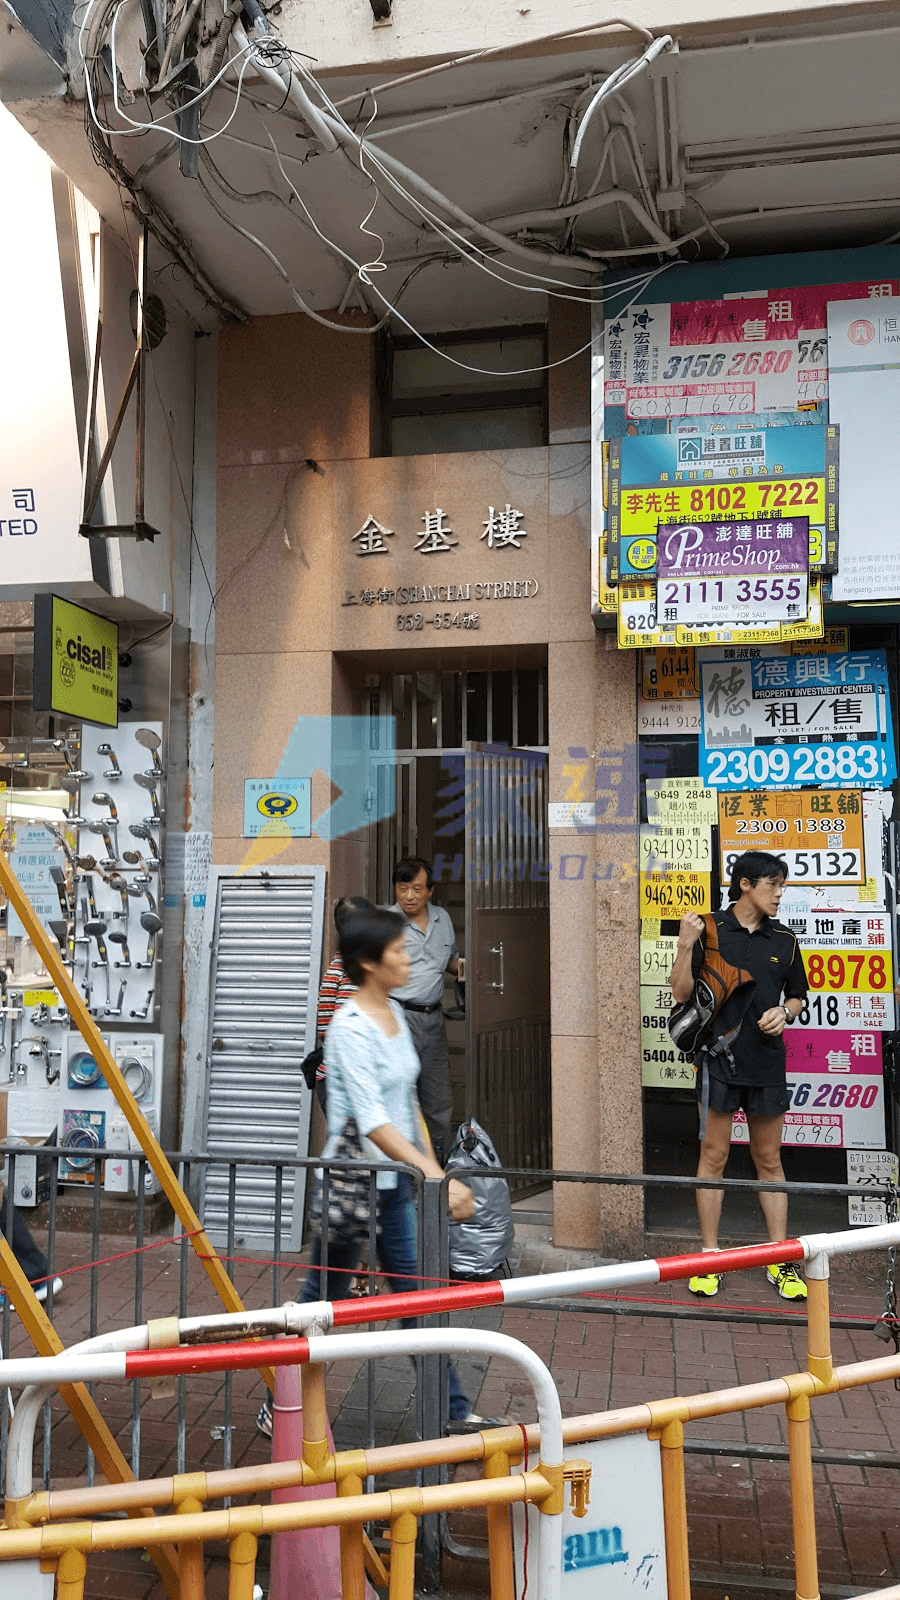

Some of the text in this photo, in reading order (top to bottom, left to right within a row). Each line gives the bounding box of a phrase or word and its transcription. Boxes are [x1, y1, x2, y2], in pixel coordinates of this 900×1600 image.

[769, 300, 793, 322] 租
[742, 319, 767, 340] 售
[883, 318, 899, 332] 恒
[633, 332, 650, 384] 宏星物業
[664, 354, 727, 379] 3156
[726, 350, 794, 376] 2680
[704, 435, 762, 452] 港置旺舖
[12, 488, 35, 512] 司
[626, 482, 819, 515] 李先生 8102 7222
[351, 504, 527, 556] 金基樓
[713, 524, 793, 542] 澎達旺舖
[664, 528, 781, 573] PrimeShop
[774, 564, 800, 574] .com.hk
[475, 578, 539, 601] STREET)
[664, 581, 723, 604] 2111
[737, 577, 801, 602] 3555
[664, 607, 679, 622] 租
[787, 603, 801, 619] 售
[397, 612, 480, 631] 652-654號
[627, 613, 657, 631] 820
[624, 634, 636, 646] 租
[682, 632, 693, 643] 租
[66, 635, 107, 671] cisal
[724, 648, 762, 658] 陳淑敏
[661, 656, 690, 677] 6144
[754, 656, 873, 689] 德興行
[755, 690, 795, 702] PROPERTY
[795, 686, 841, 700] INVESTMENT
[843, 684, 873, 697] CENTER
[642, 716, 670, 728] 9444
[765, 699, 864, 727] 租/售
[707, 749, 791, 784] 2309
[793, 745, 878, 779] 2883
[653, 790, 712, 800] 9649 2848
[721, 794, 770, 818] 恆業
[811, 793, 860, 816] 旺舖
[655, 827, 673, 837] 旺舖
[736, 818, 846, 834] 2300 1388
[643, 838, 709, 859] 93419313
[794, 853, 858, 877] 5132
[651, 873, 698, 884] 租客免佣
[645, 885, 705, 906] 9462 9580
[867, 918, 885, 948] 旺舖
[655, 939, 674, 952] 旺舖
[818, 938, 839, 947] AGENCY
[840, 938, 863, 947] LIMITED
[808, 954, 887, 990] 8978
[655, 991, 673, 1008] 招
[847, 995, 886, 1010] 租售
[786, 995, 839, 1027] 818
[845, 1012, 888, 1021] FOR LEASE
[642, 1015, 671, 1029] 958
[863, 1020, 884, 1029] SALE
[655, 1033, 668, 1043] 王
[851, 1033, 878, 1057] 租
[643, 1049, 675, 1063] 5404
[825, 1049, 852, 1073] 售
[812, 1084, 879, 1109] 2680
[850, 1154, 896, 1165] 6712 1989
[853, 1213, 874, 1223] 6712
